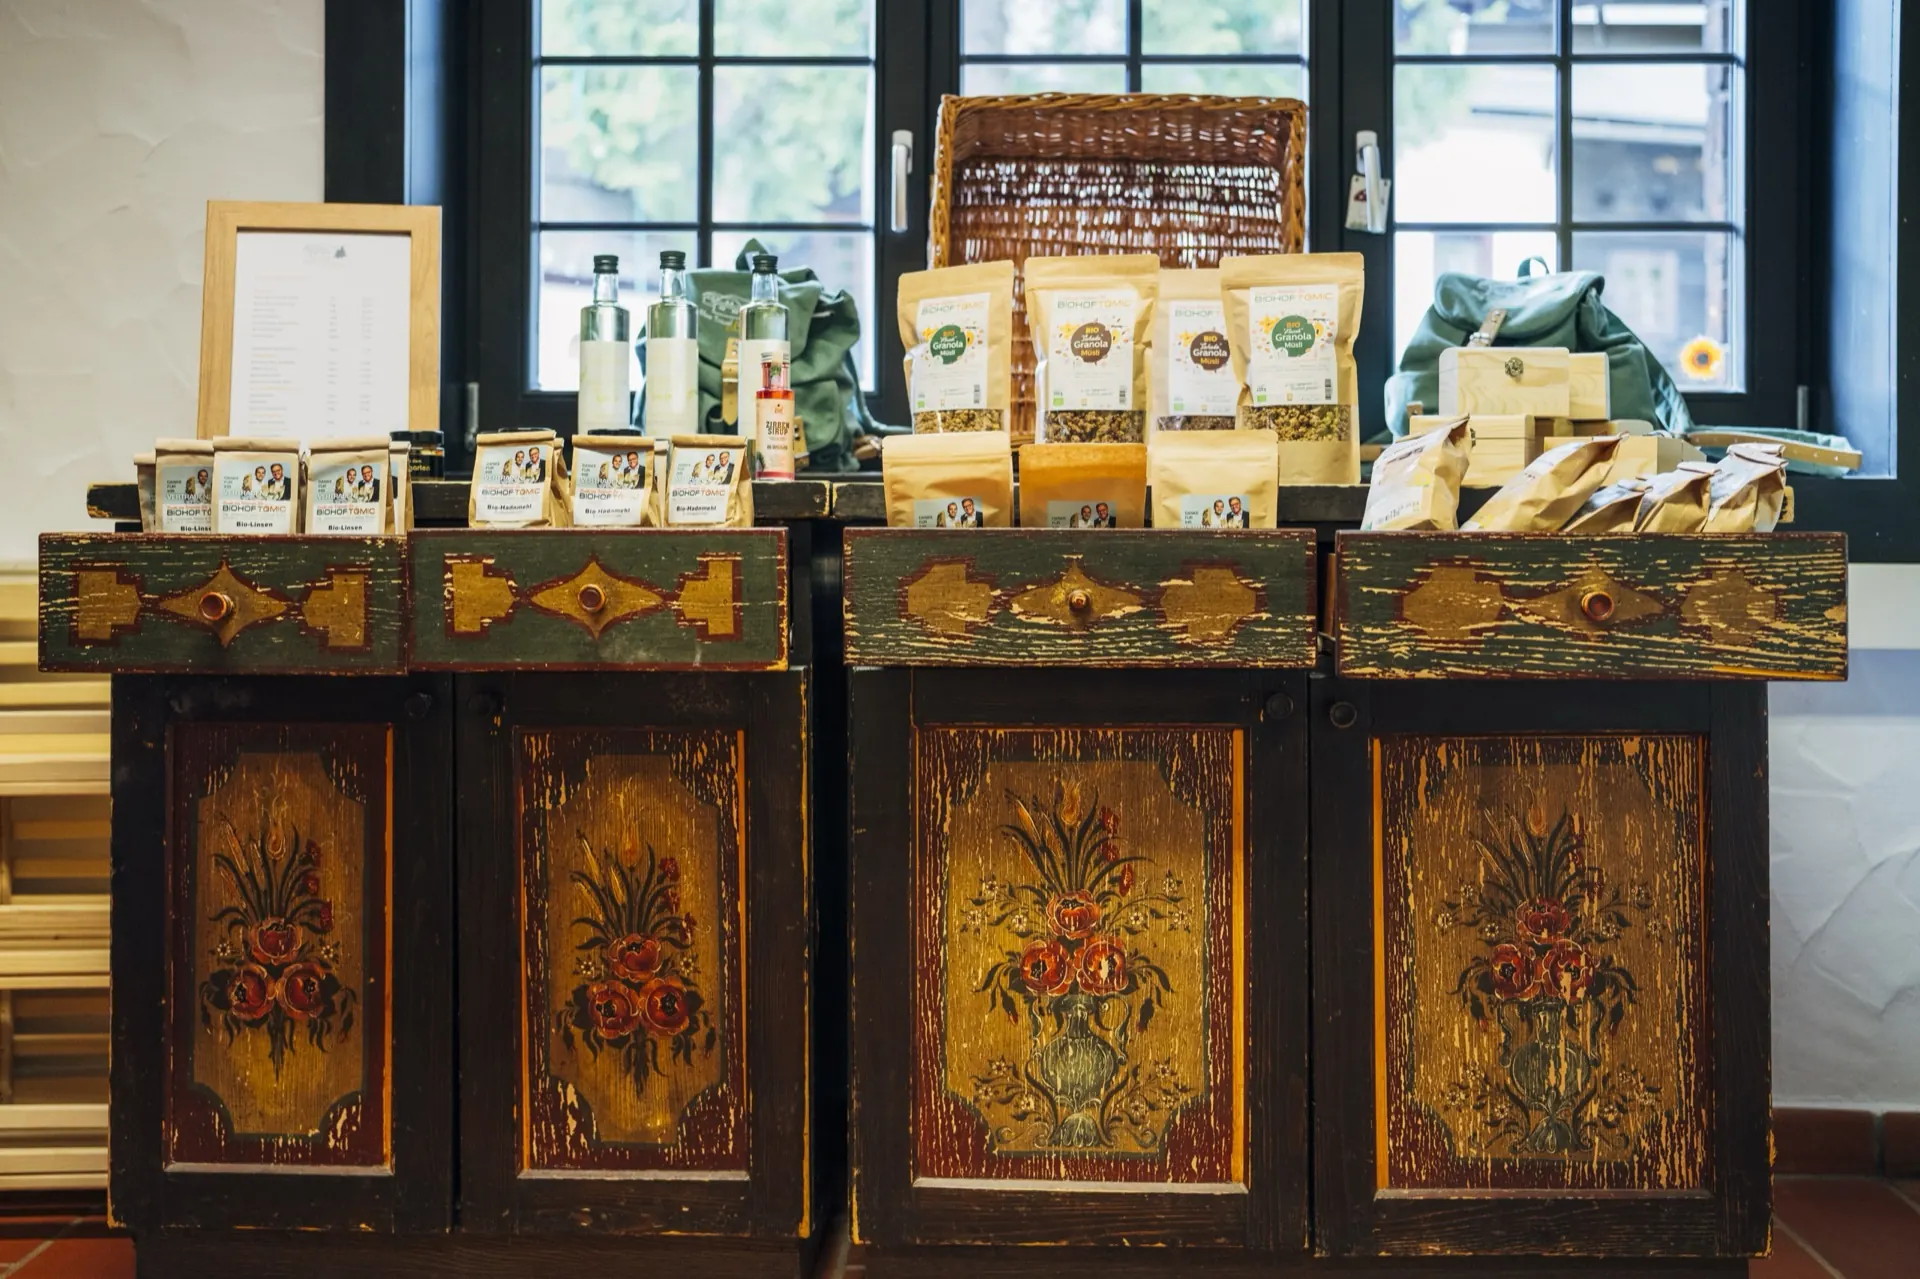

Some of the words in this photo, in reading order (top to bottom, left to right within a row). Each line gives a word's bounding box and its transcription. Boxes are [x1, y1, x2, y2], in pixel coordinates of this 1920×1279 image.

[1057, 300, 1097, 309] BIOHOF
[1203, 335, 1218, 343] BIO
[1275, 333, 1312, 342] Granola
[932, 340, 964, 350] Granola
[1073, 340, 1108, 349] Granola
[1080, 349, 1100, 357] Müsli
[1192, 349, 1228, 357] Granola
[765, 420, 790, 429] ZIRBEN
[579, 492, 612, 500] BIOHOF
[222, 505, 257, 513] BIOHOF
[257, 505, 287, 513] TOMIC
[316, 508, 348, 516] BIOHOF
[348, 507, 376, 515] TOMIC
